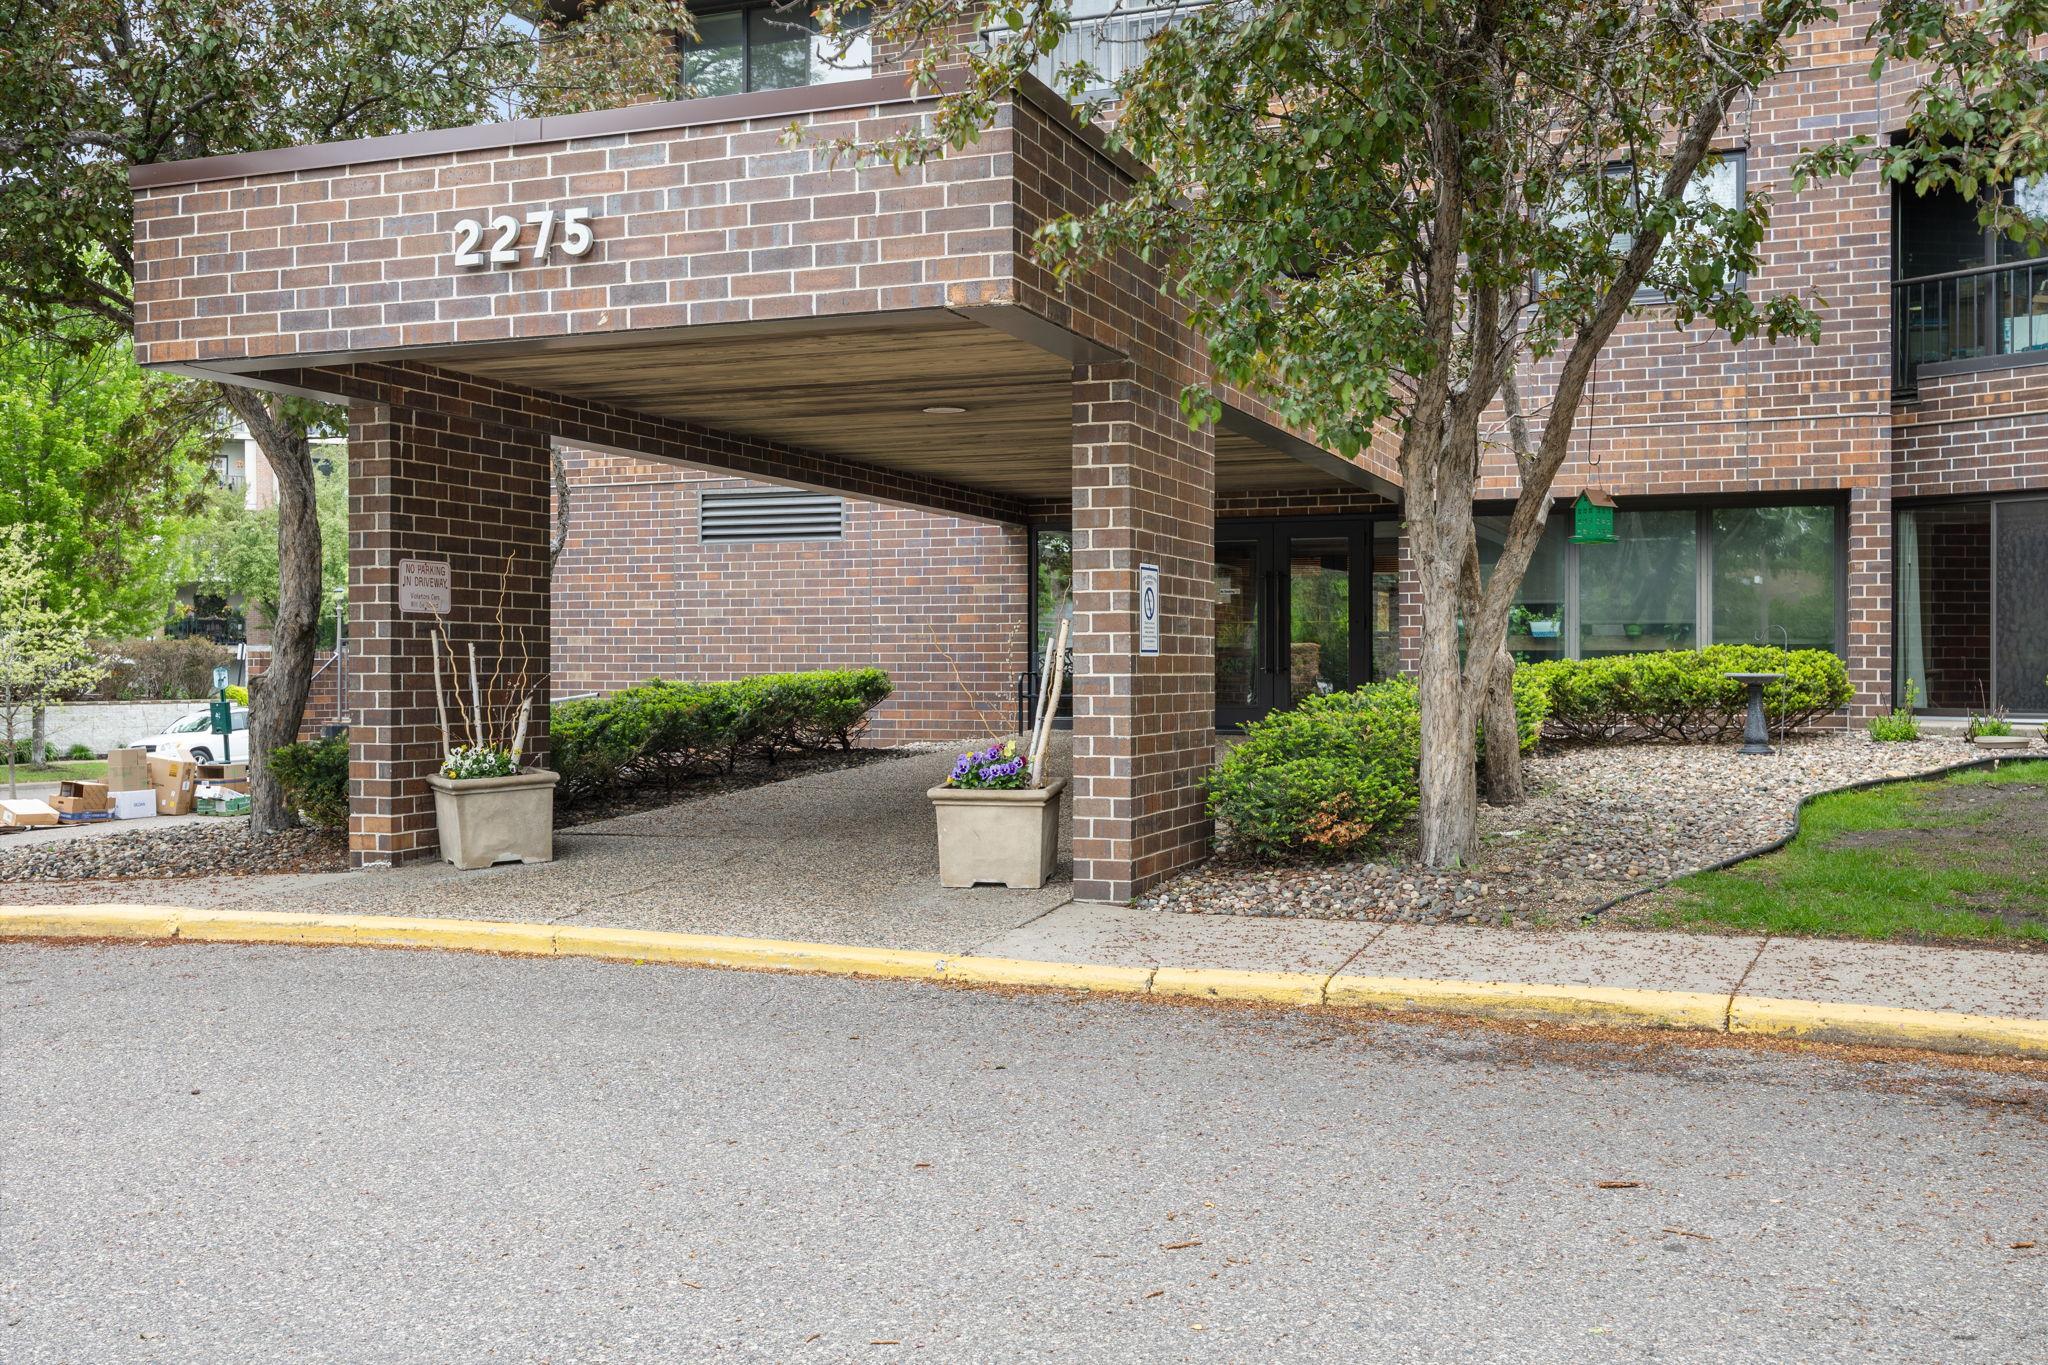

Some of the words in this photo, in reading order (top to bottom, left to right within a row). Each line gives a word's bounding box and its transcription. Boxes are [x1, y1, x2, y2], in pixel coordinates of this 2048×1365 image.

[454, 207, 594, 267] 2275
[405, 563, 415, 574] NO
[417, 564, 446, 577] PARKING
[403, 575, 412, 586] IN
[414, 576, 448, 589] DRIVEWAY
